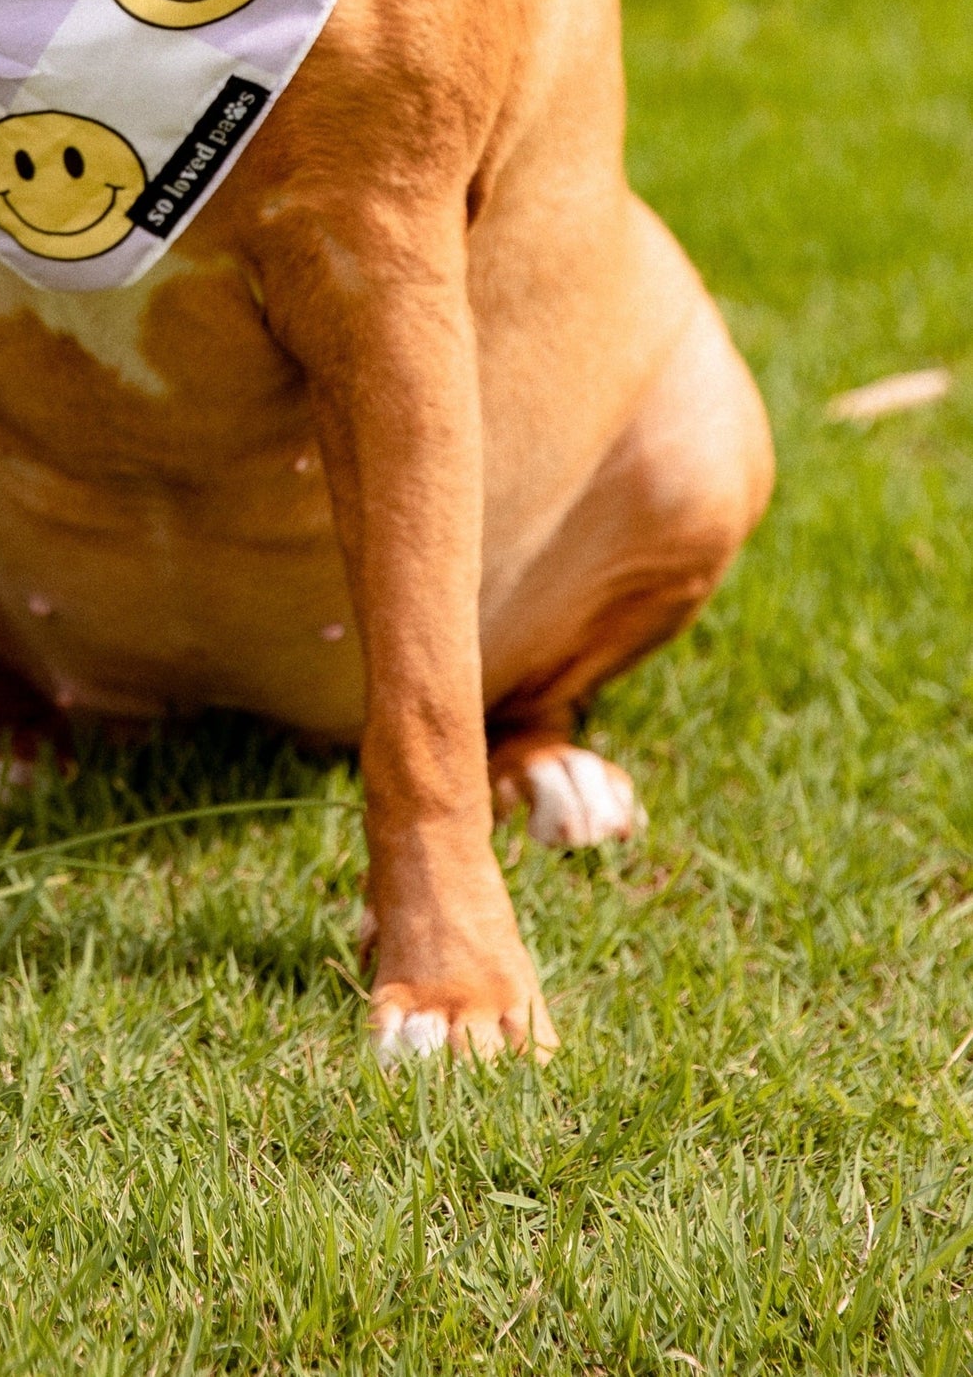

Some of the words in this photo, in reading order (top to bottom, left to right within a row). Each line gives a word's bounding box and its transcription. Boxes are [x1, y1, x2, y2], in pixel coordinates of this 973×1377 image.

[147, 198, 174, 227] so
[162, 142, 217, 199] loved
[208, 91, 256, 146] pas
